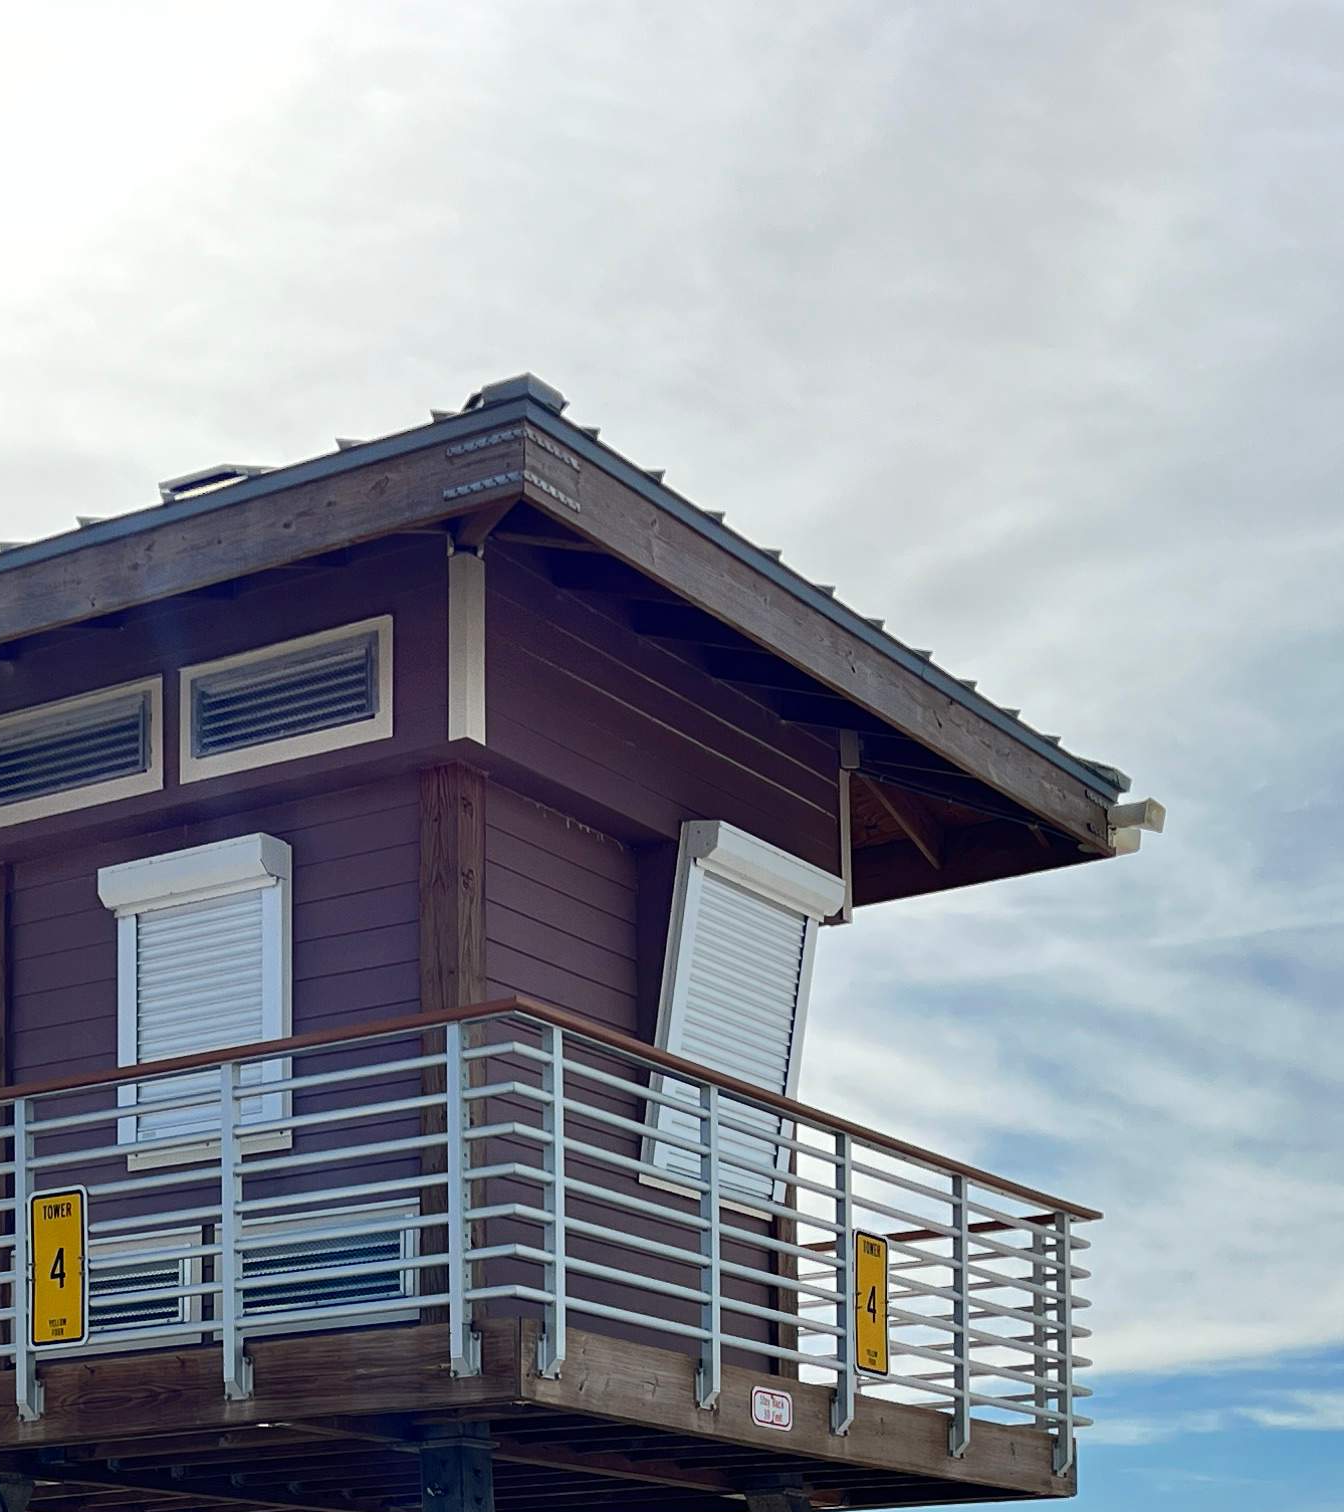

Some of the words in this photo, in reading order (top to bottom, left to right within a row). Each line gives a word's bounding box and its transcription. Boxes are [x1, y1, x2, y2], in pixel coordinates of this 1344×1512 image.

[43, 1202, 72, 1220] TOWER
[50, 1248, 66, 1288] 4
[867, 1285, 877, 1323] 4
